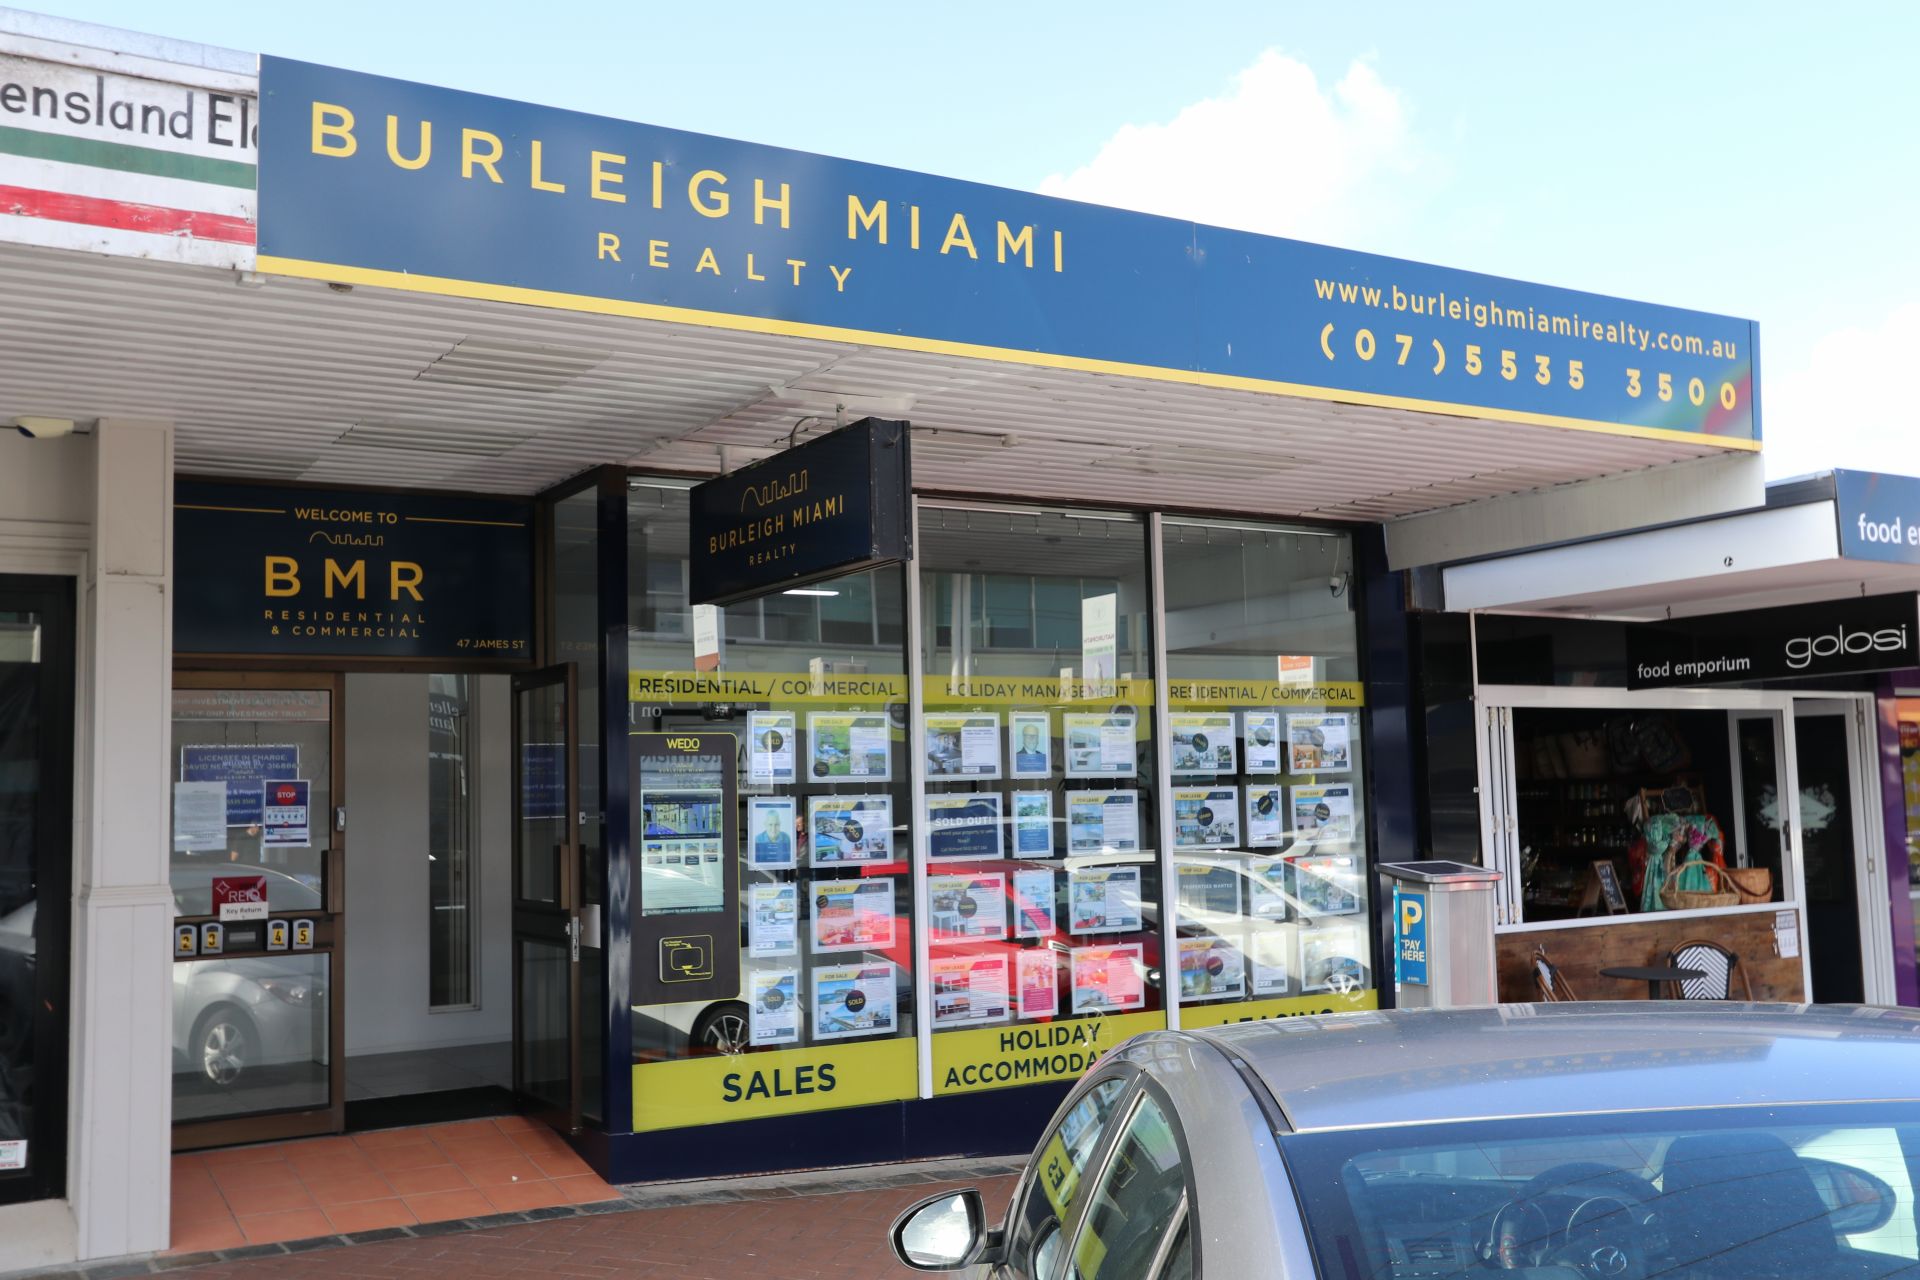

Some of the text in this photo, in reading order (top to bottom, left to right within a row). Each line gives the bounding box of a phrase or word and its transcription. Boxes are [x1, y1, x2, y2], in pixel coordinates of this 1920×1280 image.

[311, 101, 1063, 273] BURLEIGH MIAMI
[597, 232, 853, 292] REALTY
[1314, 277, 1737, 360] www.burleighmiamirealty.com.au
[1320, 322, 1736, 411] (07)5535 3500
[295, 507, 398, 525] WELCOME TO
[709, 494, 844, 554] BURLEIGH MIAMI
[1858, 512, 1902, 545] food
[749, 543, 796, 566] REALTY
[264, 555, 425, 602] BMR
[264, 610, 426, 625] RESIDENTIAL
[271, 625, 421, 639] & COMMERCIAL
[456, 639, 526, 650] 47 JAMES ST
[1785, 623, 1907, 669] golosi
[1637, 656, 1751, 680] food emporium
[639, 678, 762, 695] RESIDENTIAL
[945, 683, 1017, 698] HOLIDAY
[1170, 685, 1258, 700] RESIDENTIAL
[1271, 686, 1356, 700] COMMERCIAL
[666, 738, 701, 750] WEDO
[277, 791, 297, 799] STOP
[935, 817, 963, 828] SOLD
[226, 906, 262, 916] Key Return
[1401, 900, 1423, 936] P
[1401, 949, 1426, 963] HERE
[1404, 939, 1421, 950] PAY
[999, 1022, 1102, 1053] HOLIDAY
[944, 1050, 1108, 1088] ACCOMMODA
[722, 1062, 837, 1103] SALES
